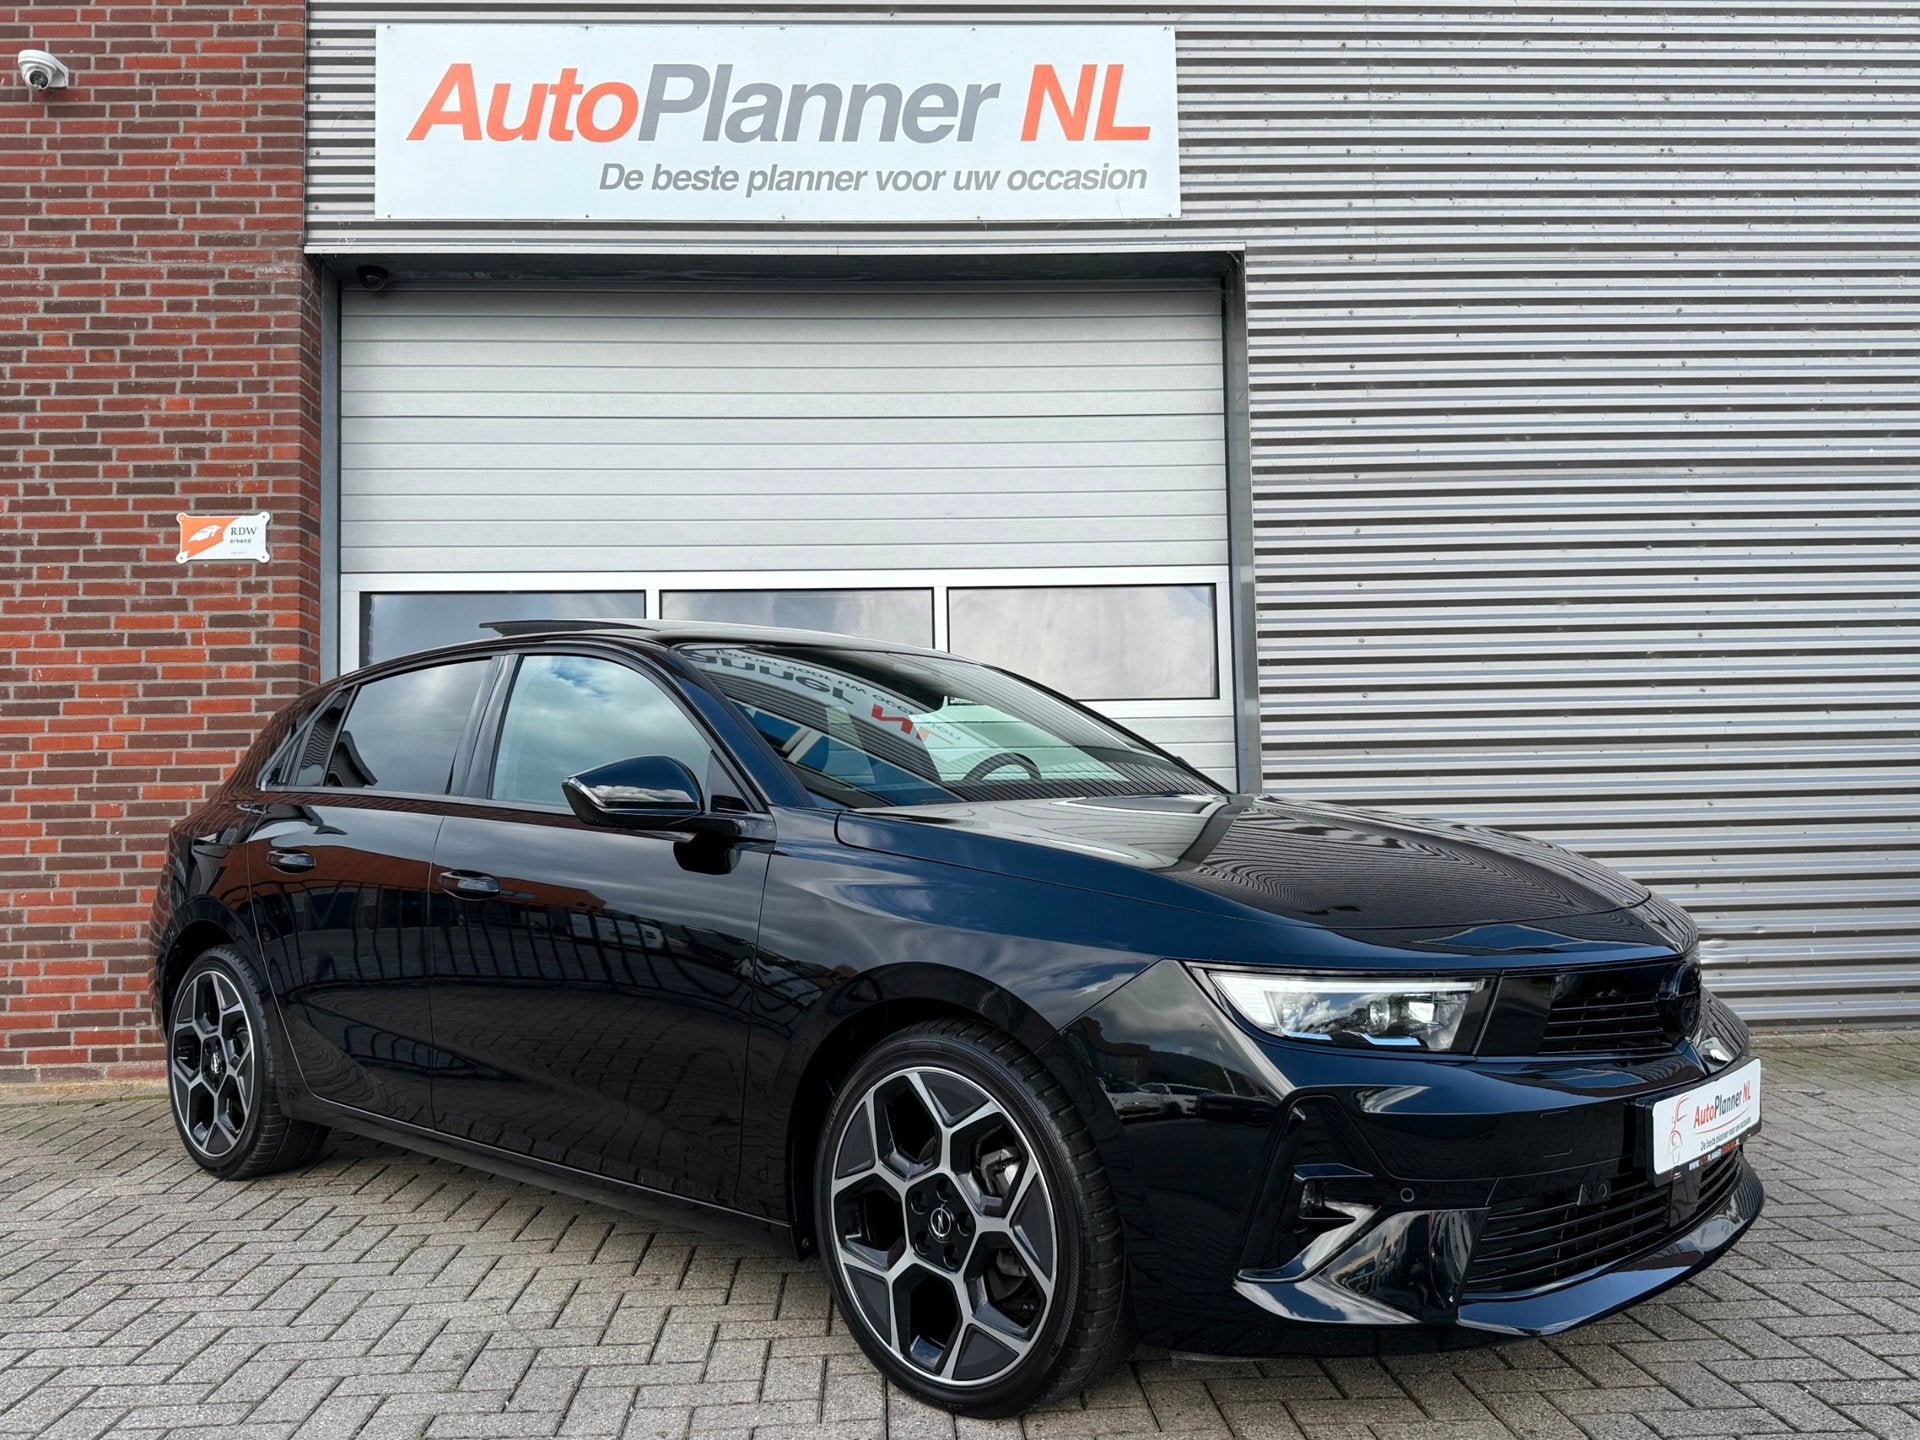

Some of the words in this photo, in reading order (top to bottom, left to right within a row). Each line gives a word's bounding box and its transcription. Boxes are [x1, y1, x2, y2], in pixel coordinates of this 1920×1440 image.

[407, 64, 1000, 143] AutoPlanner
[1022, 65, 1150, 141] NL
[600, 163, 643, 190] De
[652, 164, 739, 191] beste
[746, 164, 868, 198] planner
[876, 170, 946, 191] voor
[954, 170, 1001, 190] uw
[1008, 163, 1147, 190] occasion
[230, 527, 257, 536] RDW
[1693, 1090, 1742, 1128] AutoPlanner
[1743, 1080, 1751, 1103] NL
